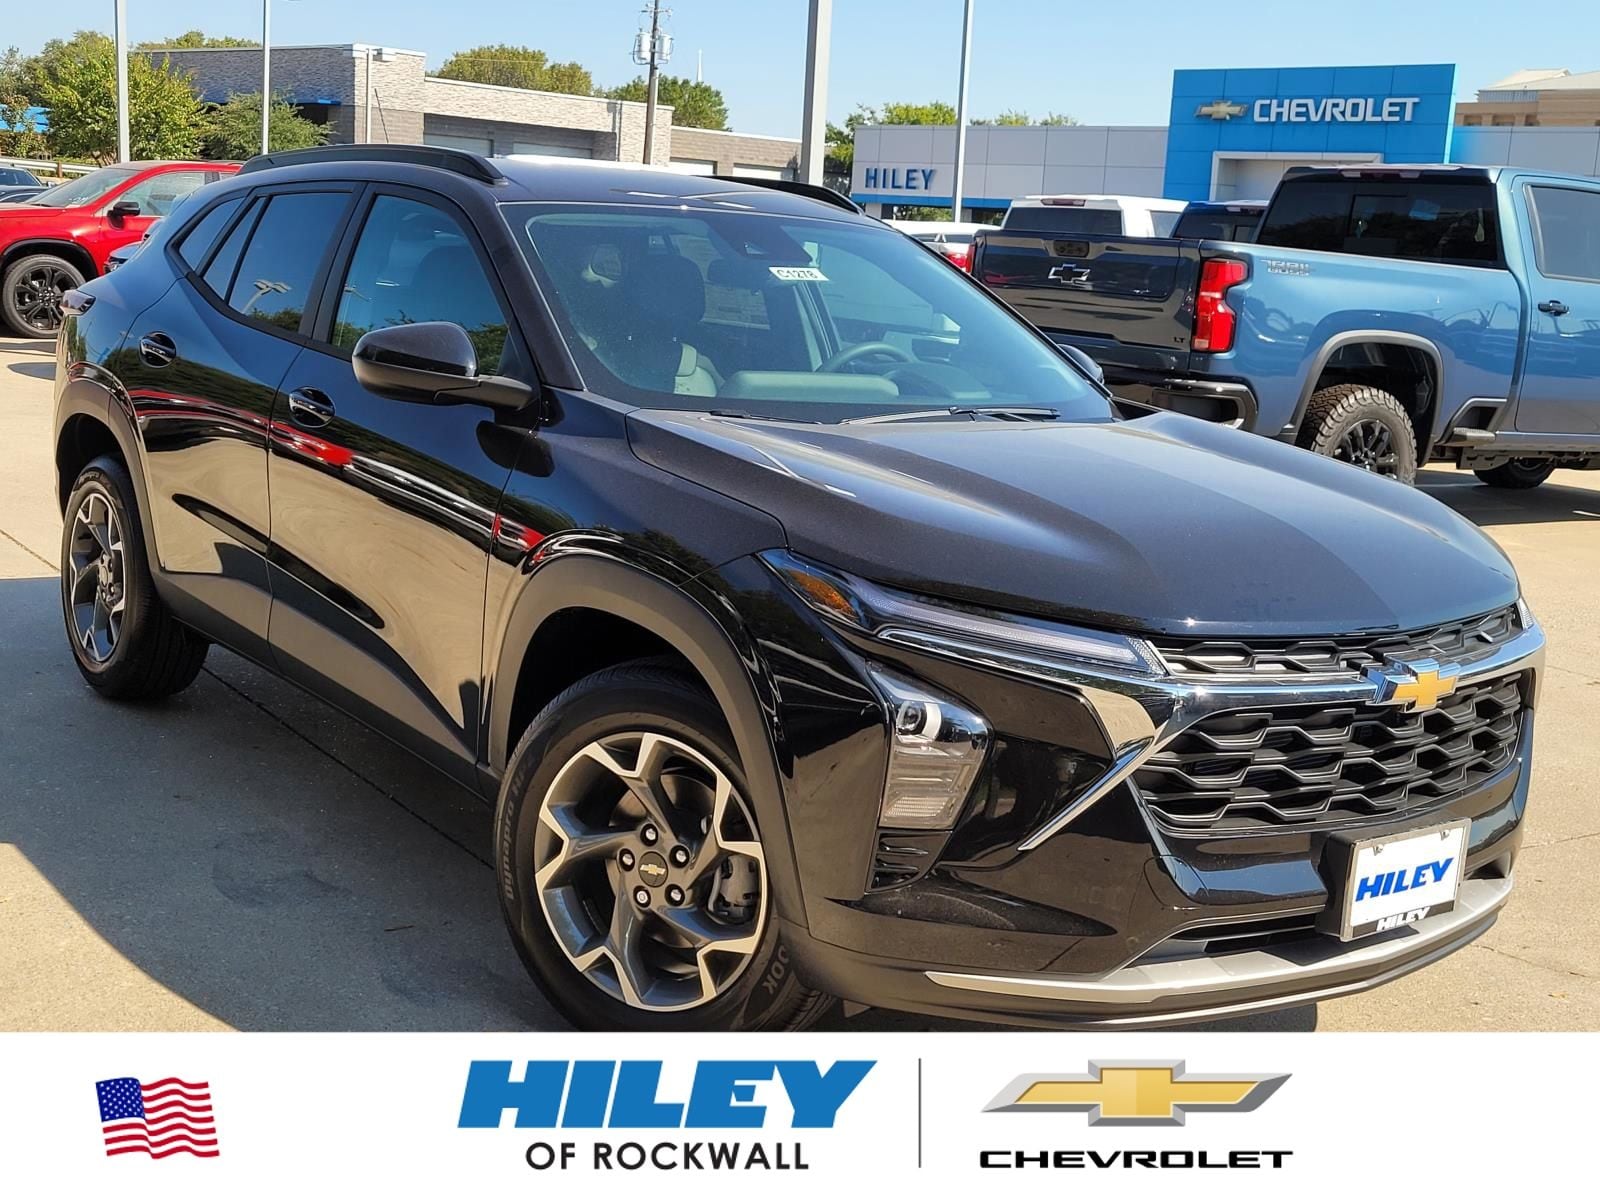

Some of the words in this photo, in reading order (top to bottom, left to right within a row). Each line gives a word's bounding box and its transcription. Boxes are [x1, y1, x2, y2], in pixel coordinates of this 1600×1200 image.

[1254, 97, 1420, 123] CHEVROLET
[865, 167, 936, 190] HILEY
[502, 800, 515, 900] Dynapro
[1355, 857, 1454, 902] HILEY
[1376, 906, 1431, 931] HILEY
